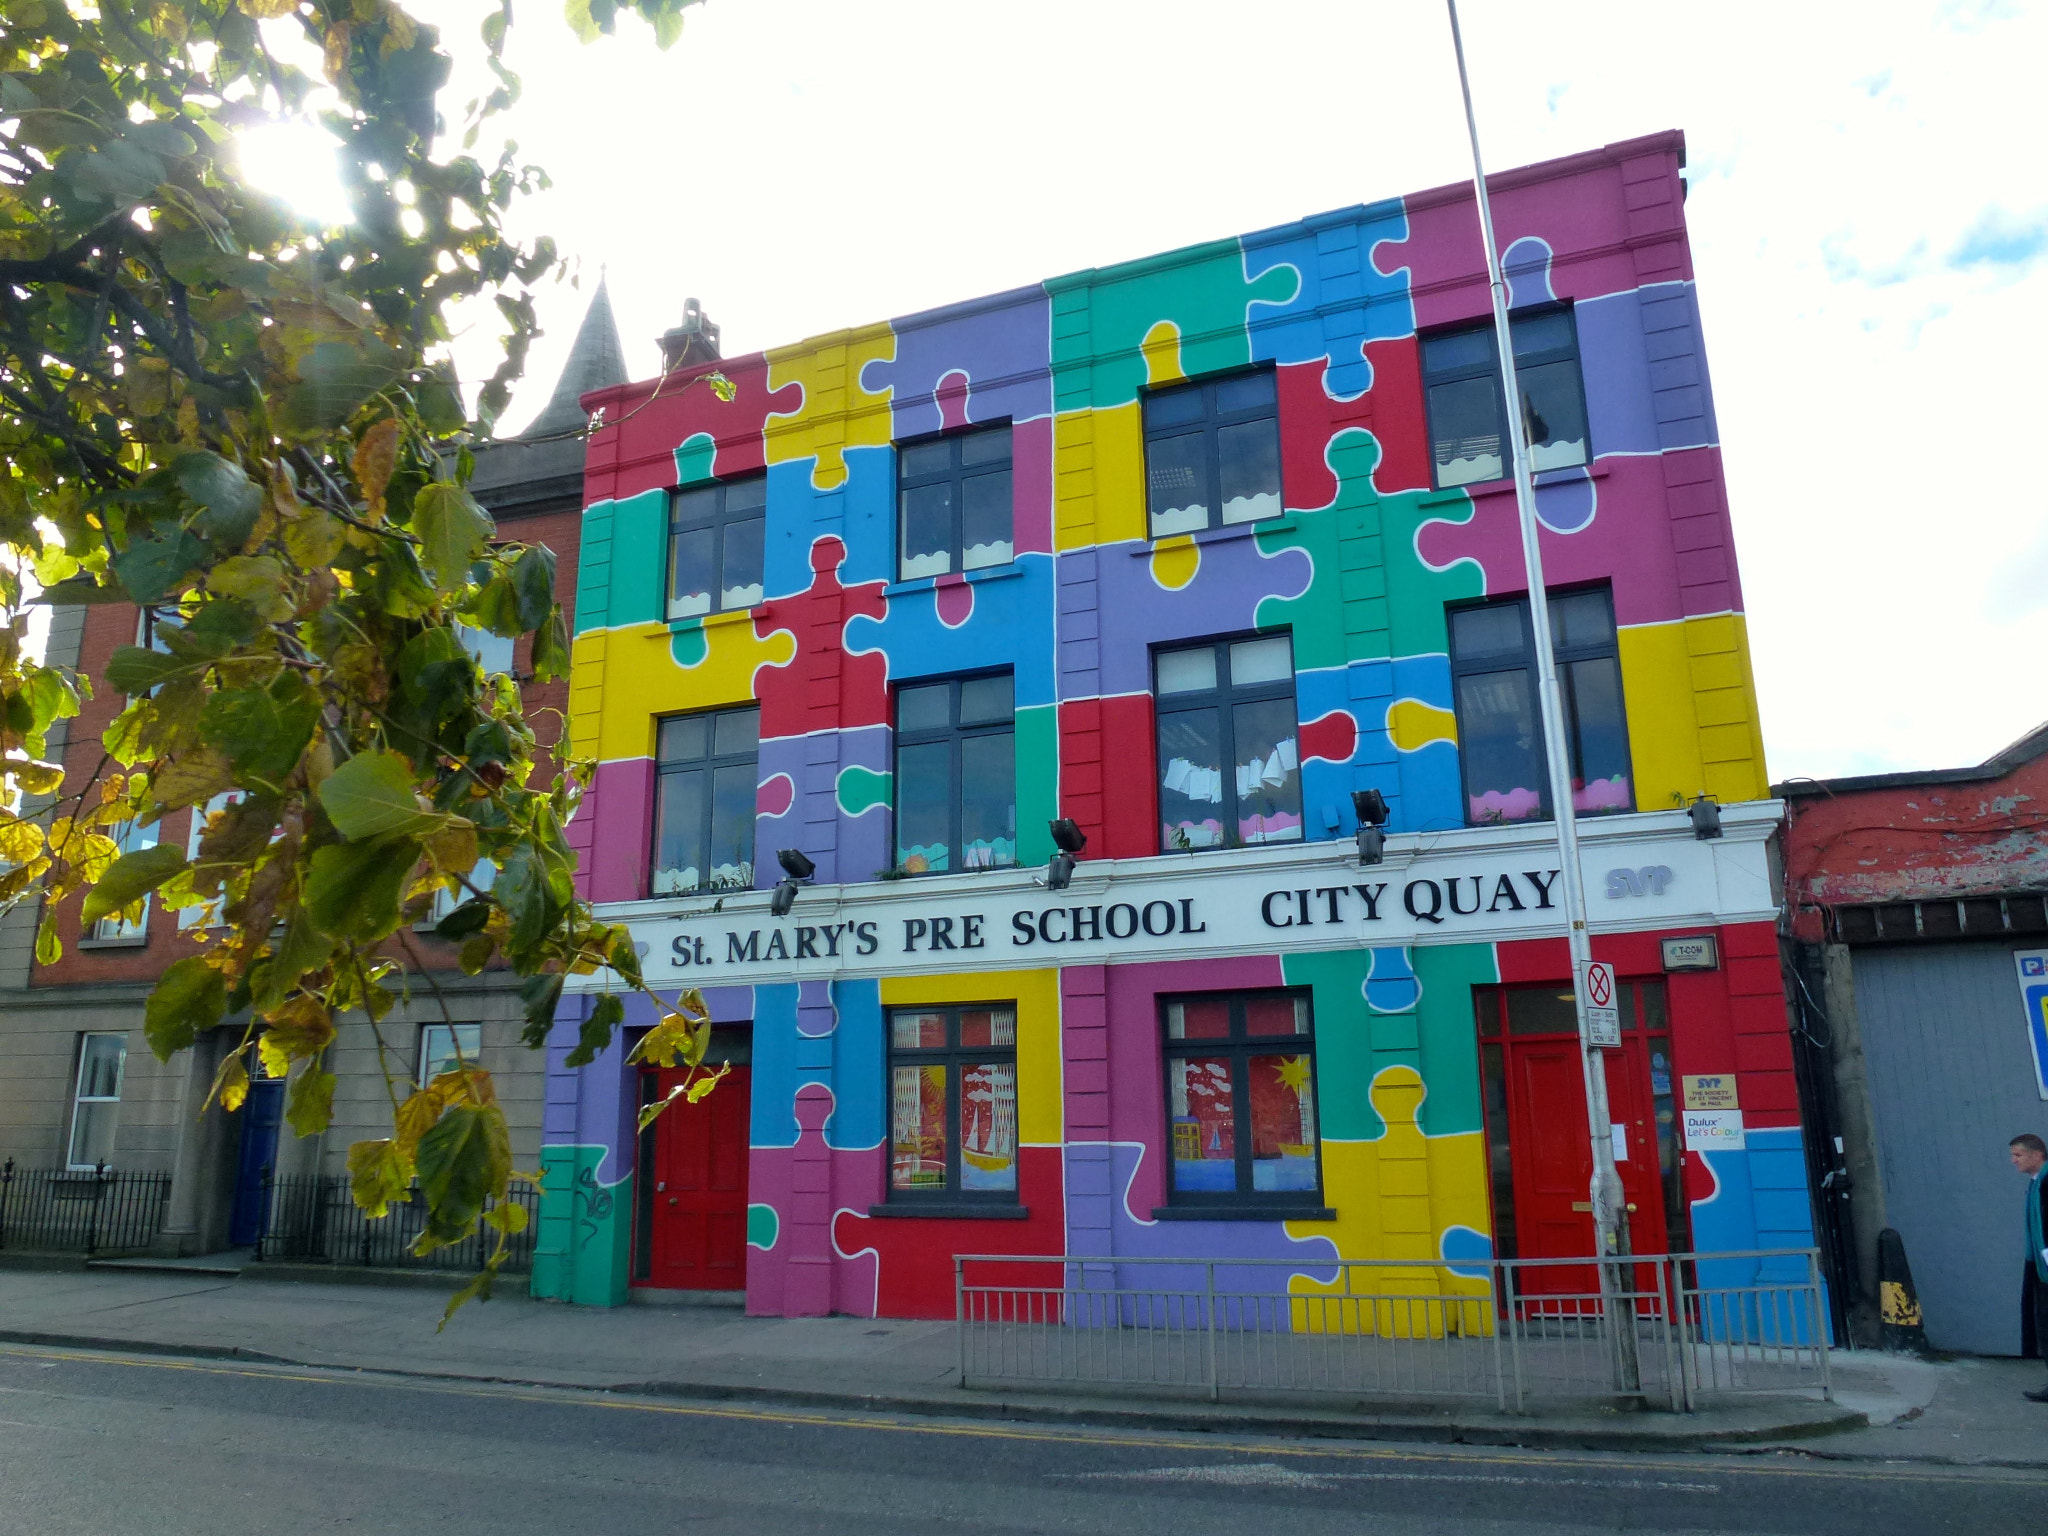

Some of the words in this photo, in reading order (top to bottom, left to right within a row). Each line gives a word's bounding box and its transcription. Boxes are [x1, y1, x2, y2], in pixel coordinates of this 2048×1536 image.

[1606, 865, 1673, 899] SVP
[671, 935, 712, 967] St.
[725, 920, 879, 963] MARY'S
[902, 914, 985, 952] PRE
[1012, 898, 1206, 946] SCHOOL
[1261, 883, 1388, 928] CITY
[1404, 869, 1561, 924] QUAY
[1697, 1077, 1721, 1089] SVP
[1688, 1117, 1718, 1127] Dulux
[1687, 1127, 1709, 1137] Let's
[1710, 1126, 1741, 1137] Colour
